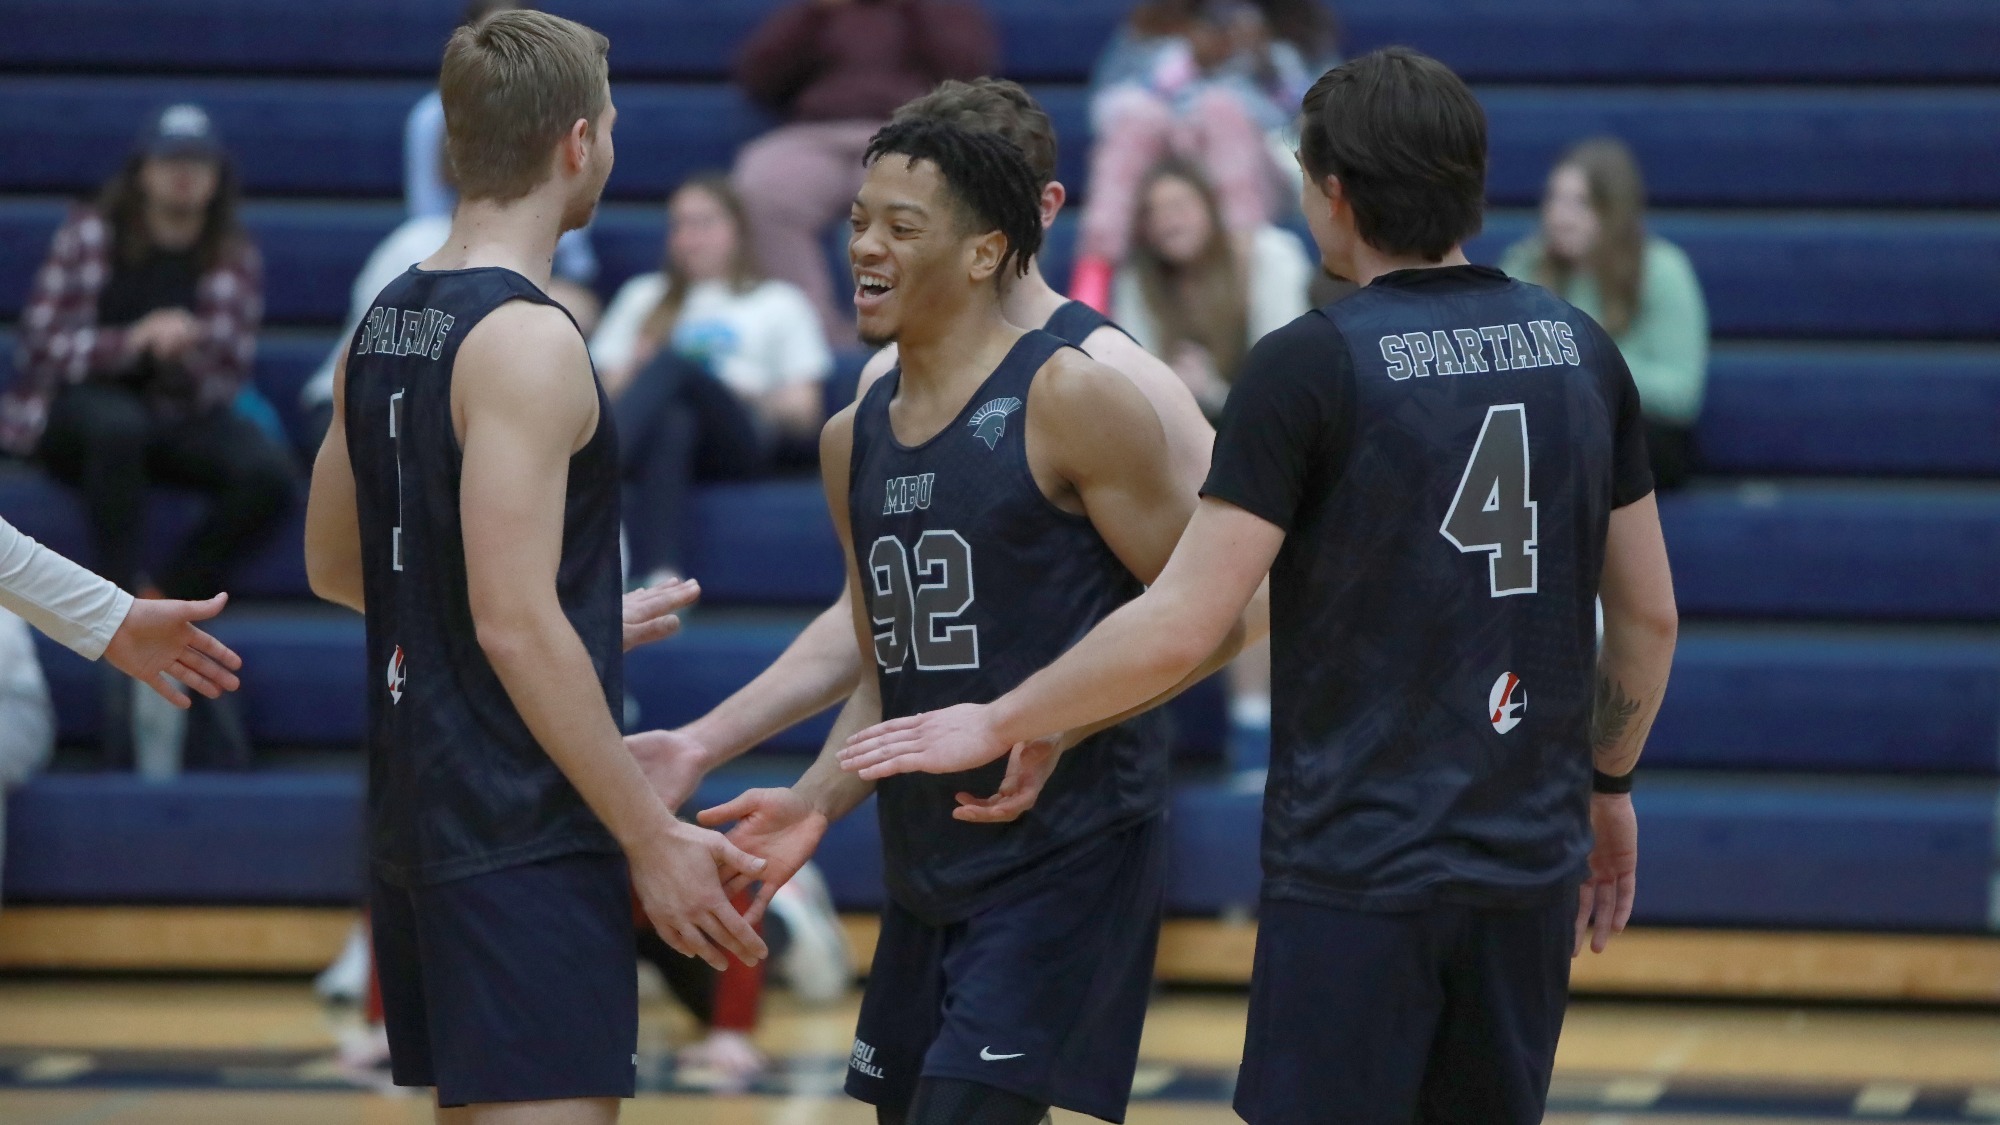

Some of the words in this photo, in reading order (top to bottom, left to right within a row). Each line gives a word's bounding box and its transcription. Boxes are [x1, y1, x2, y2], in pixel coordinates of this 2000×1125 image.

[1379, 319, 1580, 381] SPARTANS
[883, 473, 935, 515] MBU
[1439, 403, 1538, 597] 4
[869, 529, 980, 674] 92
